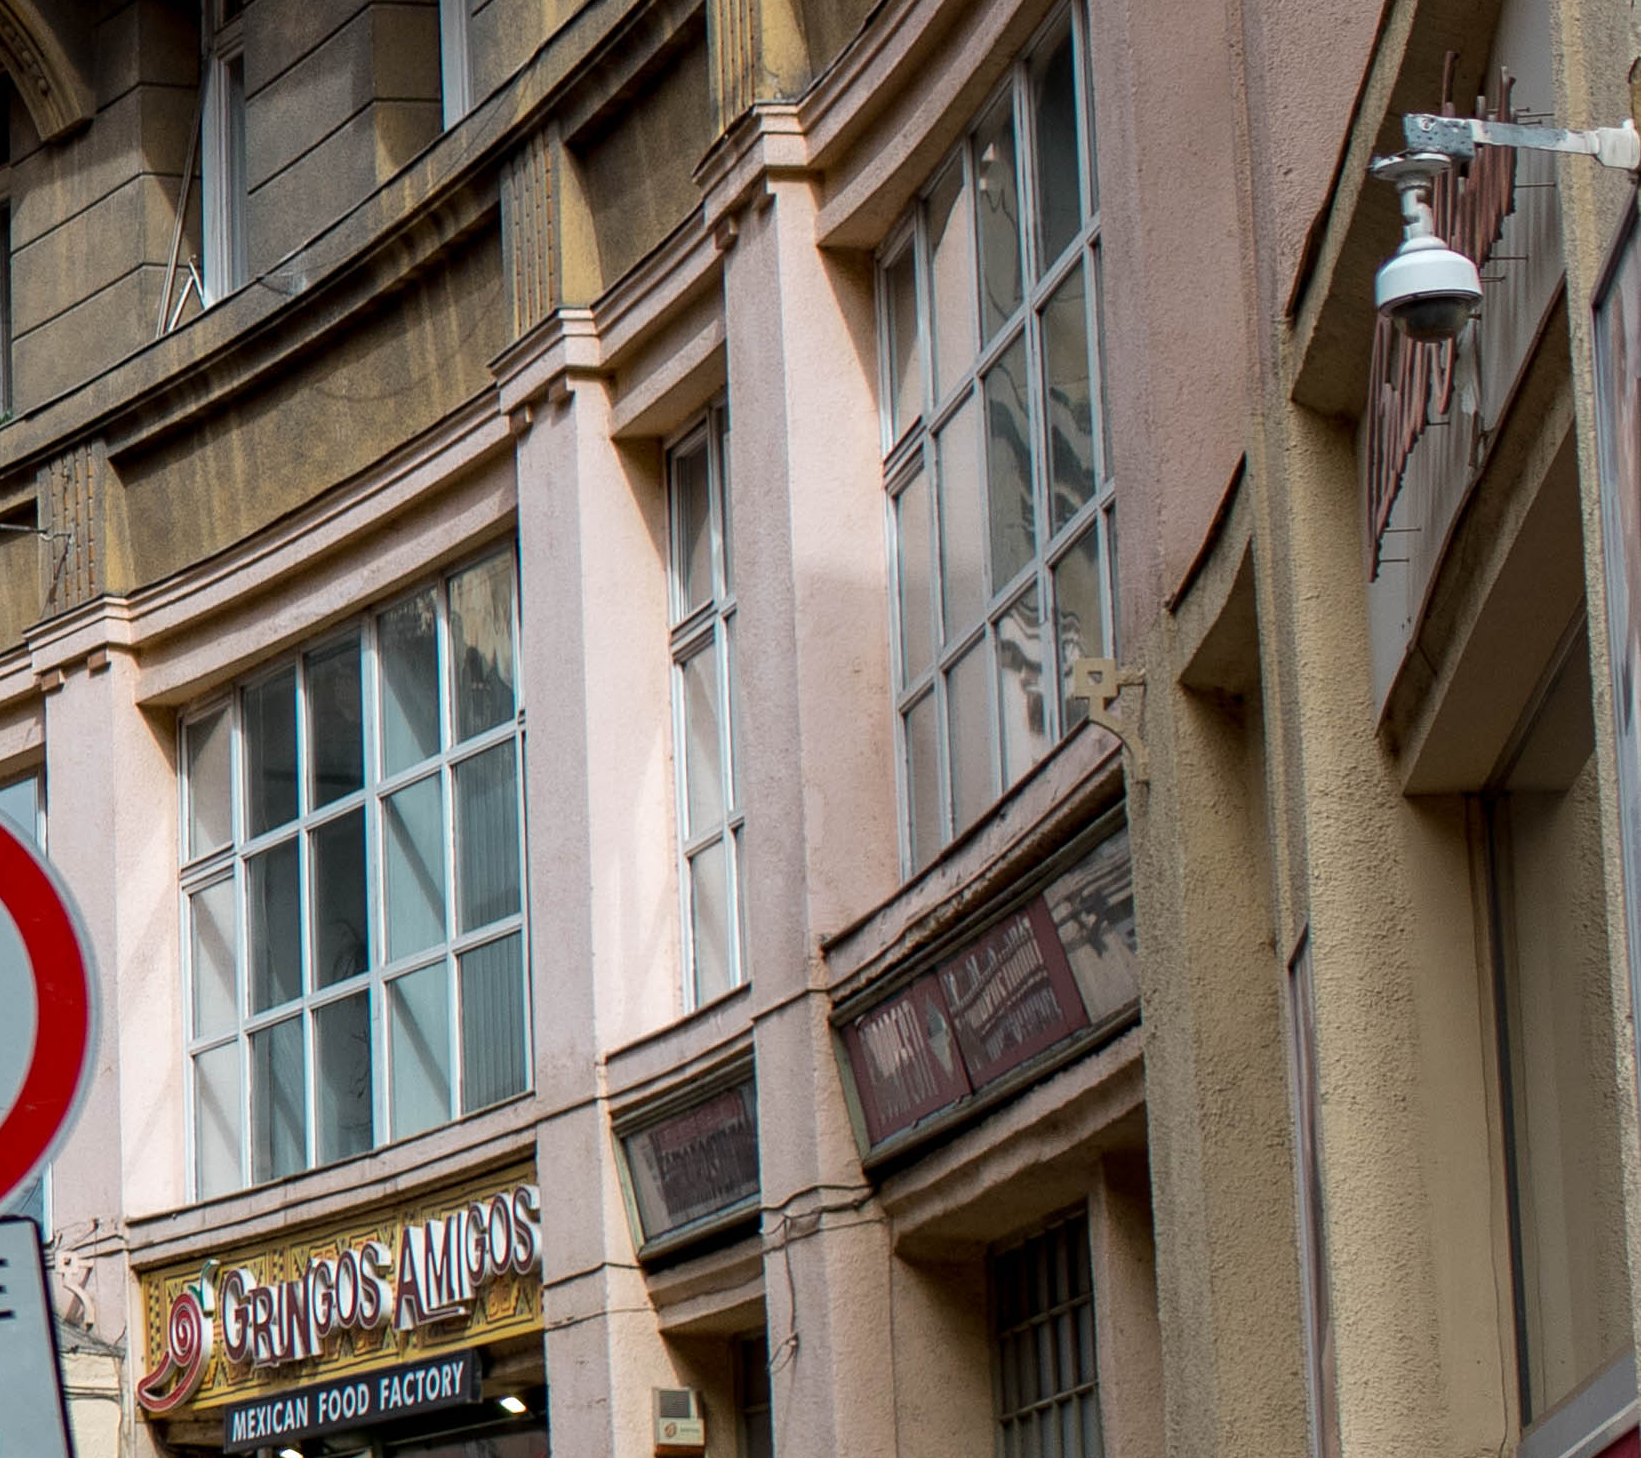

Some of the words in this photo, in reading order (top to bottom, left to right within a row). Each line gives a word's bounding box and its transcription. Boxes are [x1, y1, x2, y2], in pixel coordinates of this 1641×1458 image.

[220, 1239, 392, 1369] GRINGOS
[394, 1184, 540, 1331] AMIGOS
[231, 1396, 308, 1442] MEXICAN
[317, 1382, 370, 1424] FOOD
[380, 1361, 465, 1412] FACTORY
